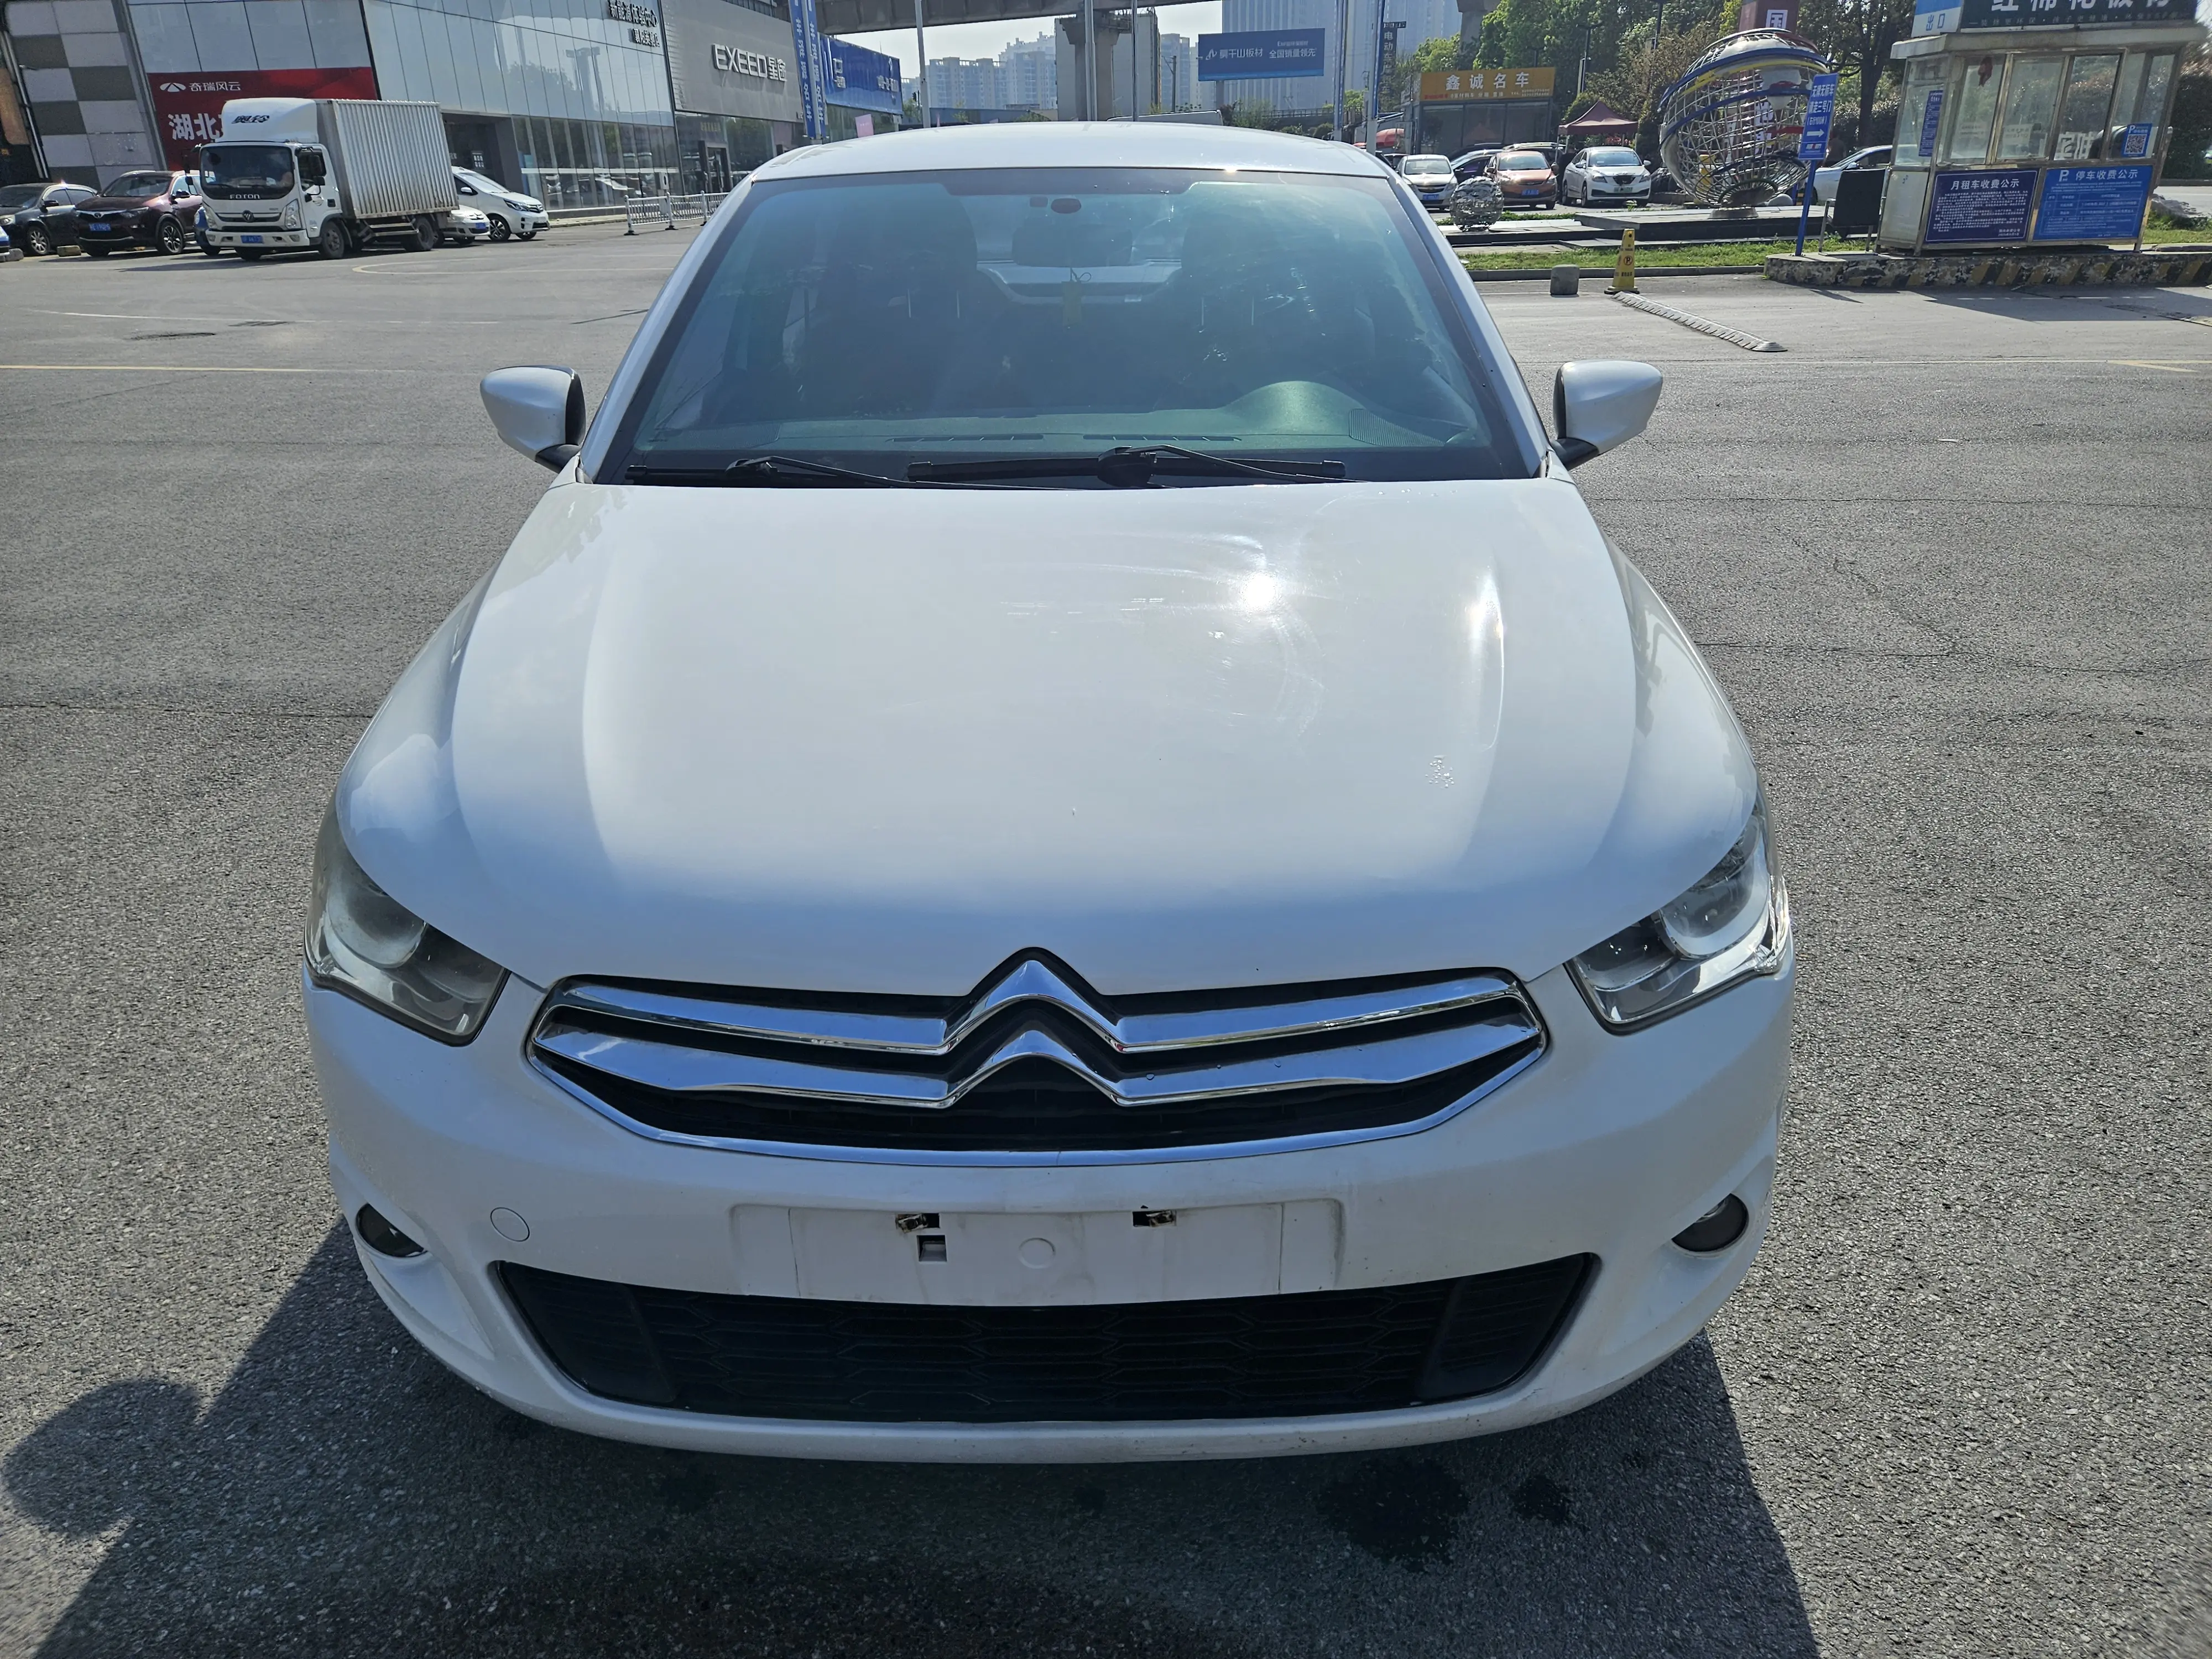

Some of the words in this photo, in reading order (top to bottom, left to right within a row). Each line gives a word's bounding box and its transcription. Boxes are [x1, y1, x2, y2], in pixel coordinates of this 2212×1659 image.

[1926, 13, 1945, 31] 出口
[1219, 48, 1263, 59] 莫干山板材
[1269, 48, 1316, 59] 全国销量领先
[712, 44, 768, 78] EXEED
[768, 56, 787, 82] 星途
[189, 81, 241, 92] 奇瑞风云
[1446, 71, 1530, 91] 鑫诚名车
[168, 113, 222, 140] 湖北
[2075, 169, 2138, 181] 停车收费公示
[1950, 178, 2020, 190] 月租车收费公示
